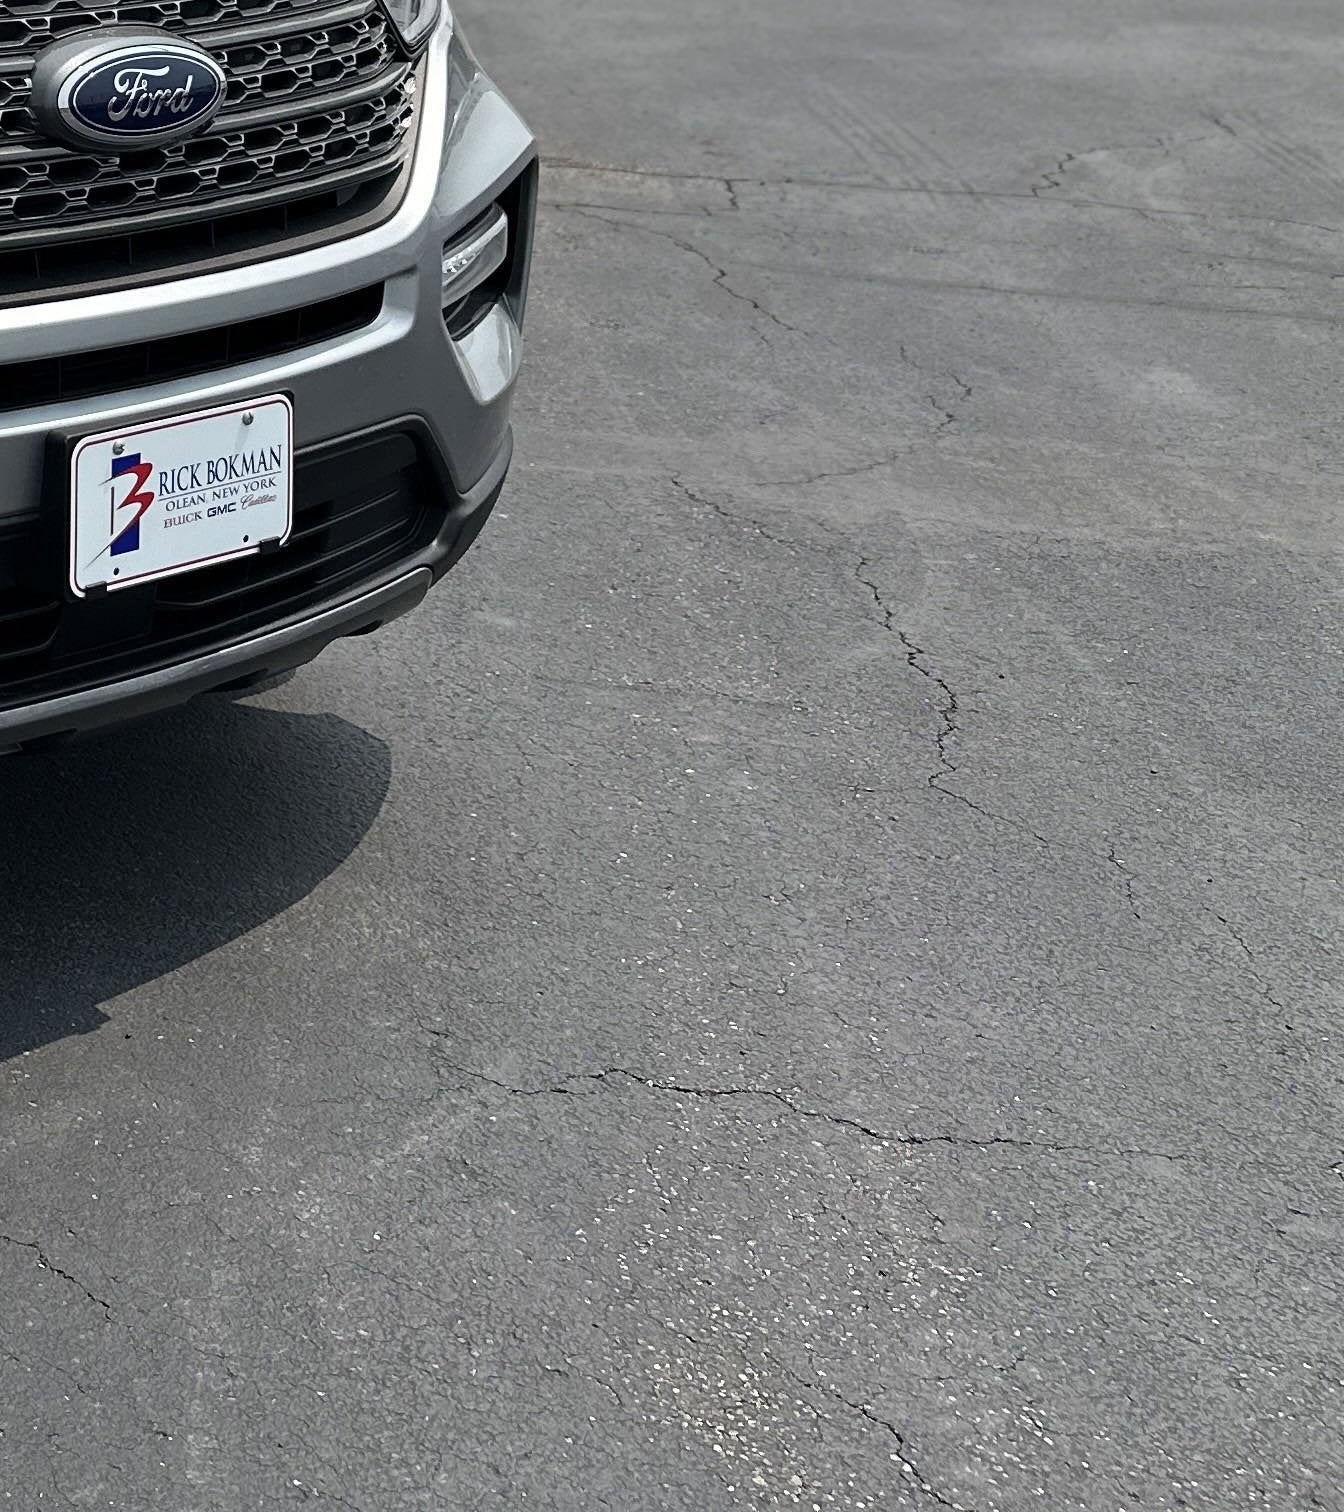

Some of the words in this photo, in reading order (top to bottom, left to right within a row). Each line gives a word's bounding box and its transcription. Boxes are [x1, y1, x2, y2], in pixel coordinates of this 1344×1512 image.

[107, 65, 194, 122] Ford
[158, 462, 202, 496] RICK
[206, 444, 282, 485] BOKMAN
[212, 485, 240, 502] NEW
[243, 477, 277, 494] YORK
[164, 510, 203, 528] BUICK
[207, 502, 237, 518] GMC
